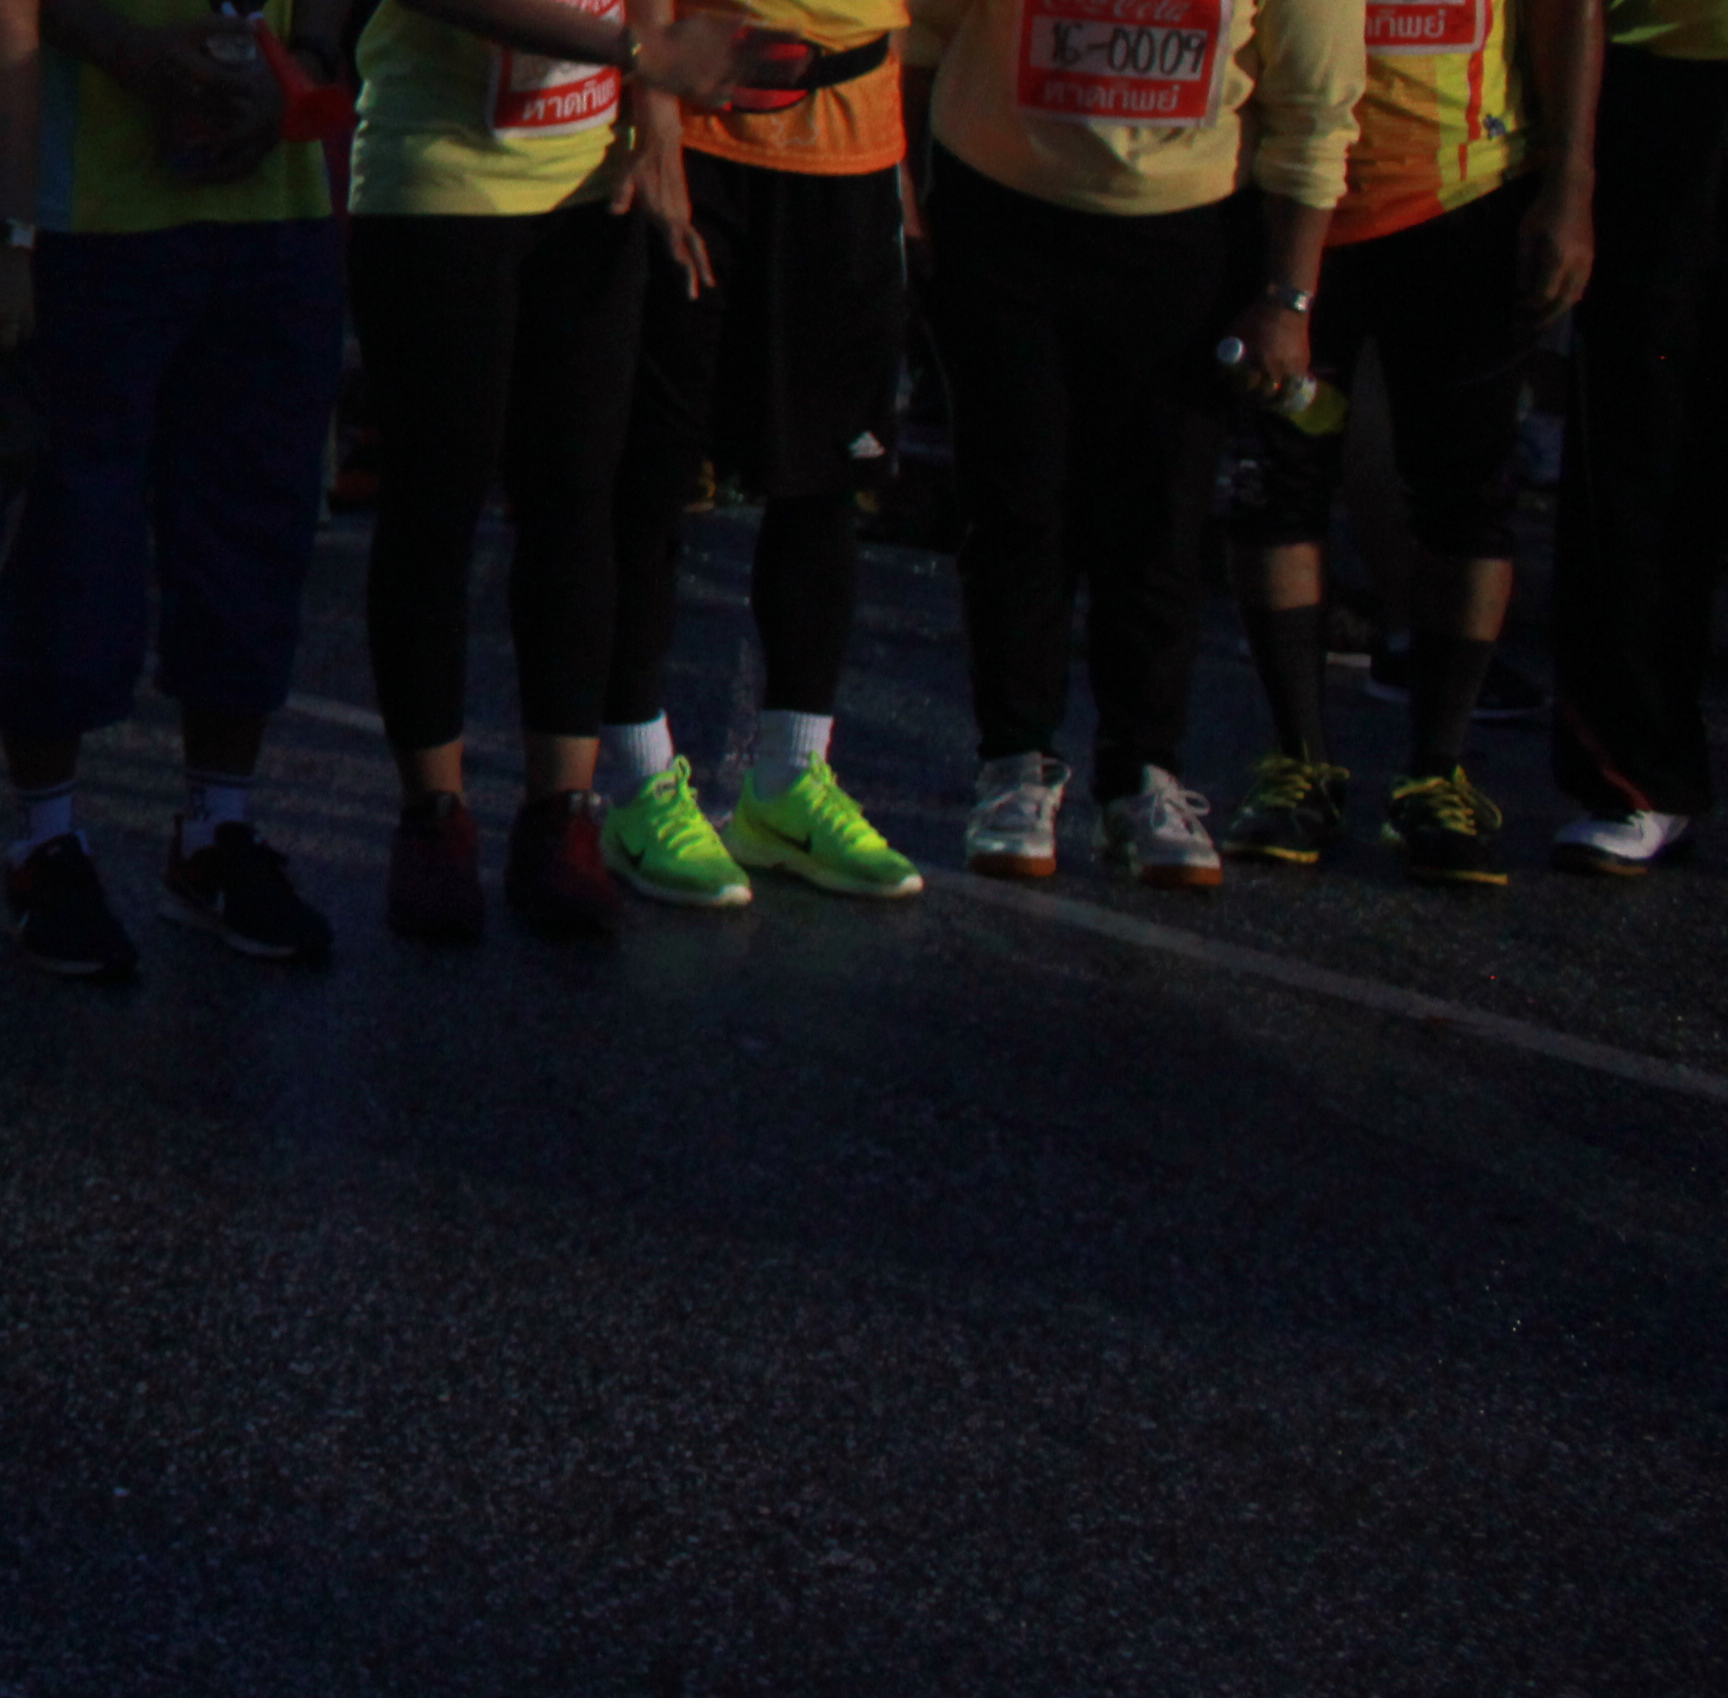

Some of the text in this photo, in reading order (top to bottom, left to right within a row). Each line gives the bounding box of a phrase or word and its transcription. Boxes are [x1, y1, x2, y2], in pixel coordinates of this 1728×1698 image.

[1366, 8, 1448, 39] ทิพย์
[522, 75, 617, 121] หาดทิพ
[1042, 80, 1182, 113] หาดทิพย์
